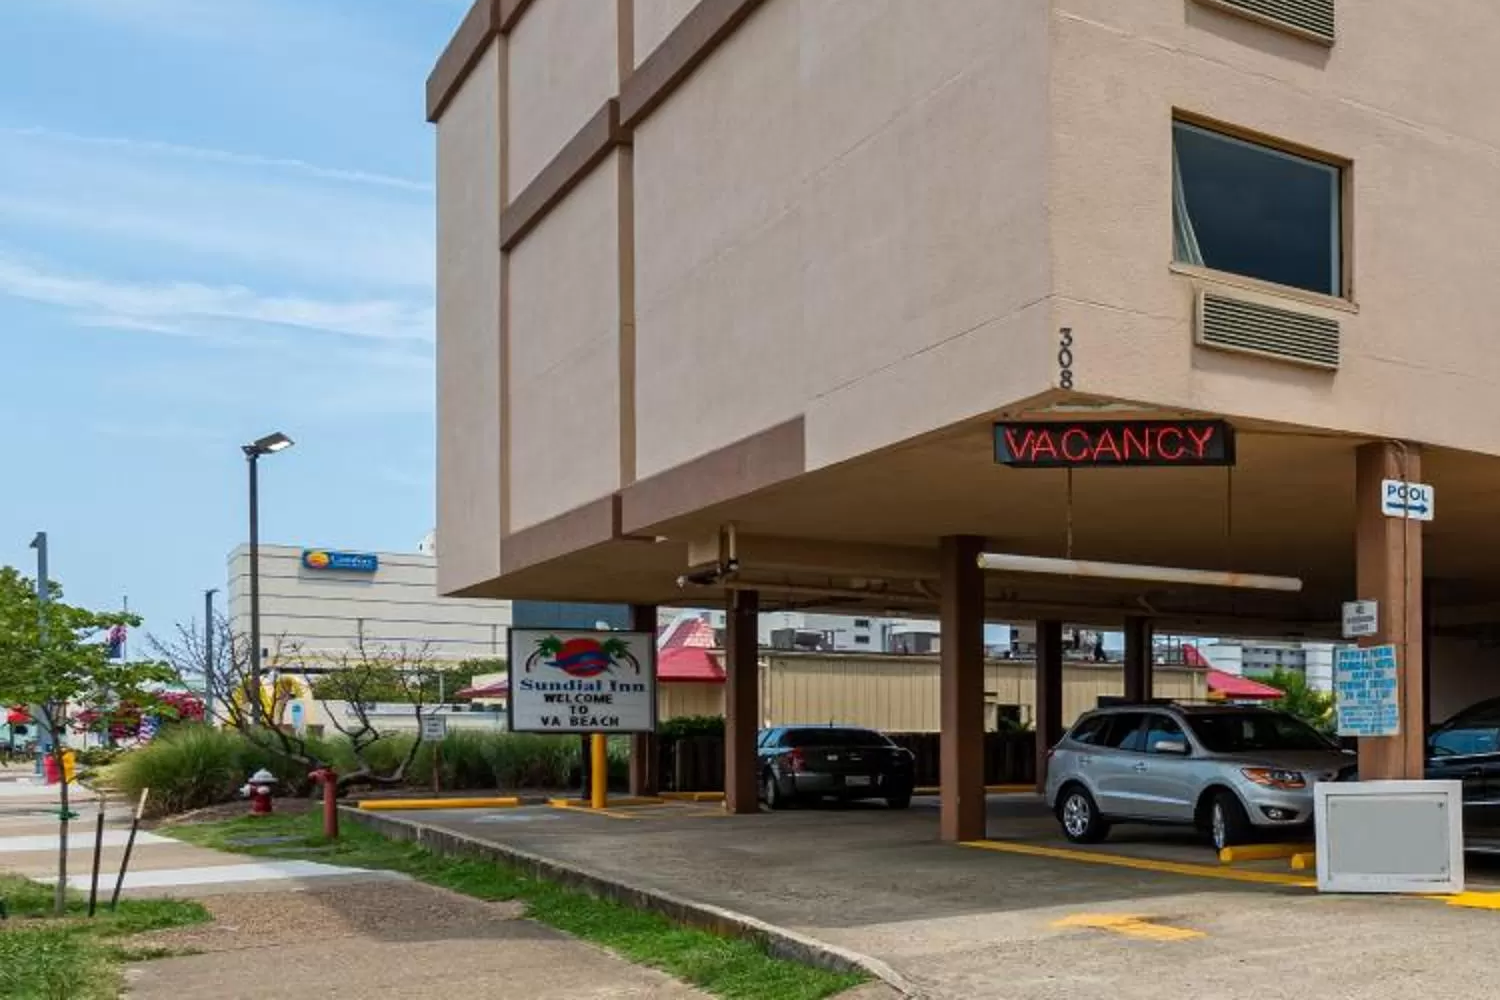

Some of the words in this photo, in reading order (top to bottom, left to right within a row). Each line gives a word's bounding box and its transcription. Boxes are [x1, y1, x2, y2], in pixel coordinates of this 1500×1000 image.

[1058, 327, 1073, 390] 308
[1004, 425, 1215, 462] VACANCY
[1387, 484, 1428, 501] POOL
[519, 678, 603, 692] Sundial
[608, 679, 646, 693] Inn
[543, 693, 614, 705] WELCOME
[569, 705, 589, 715] TO
[541, 715, 561, 727] VA
[569, 716, 620, 727] BEACH
